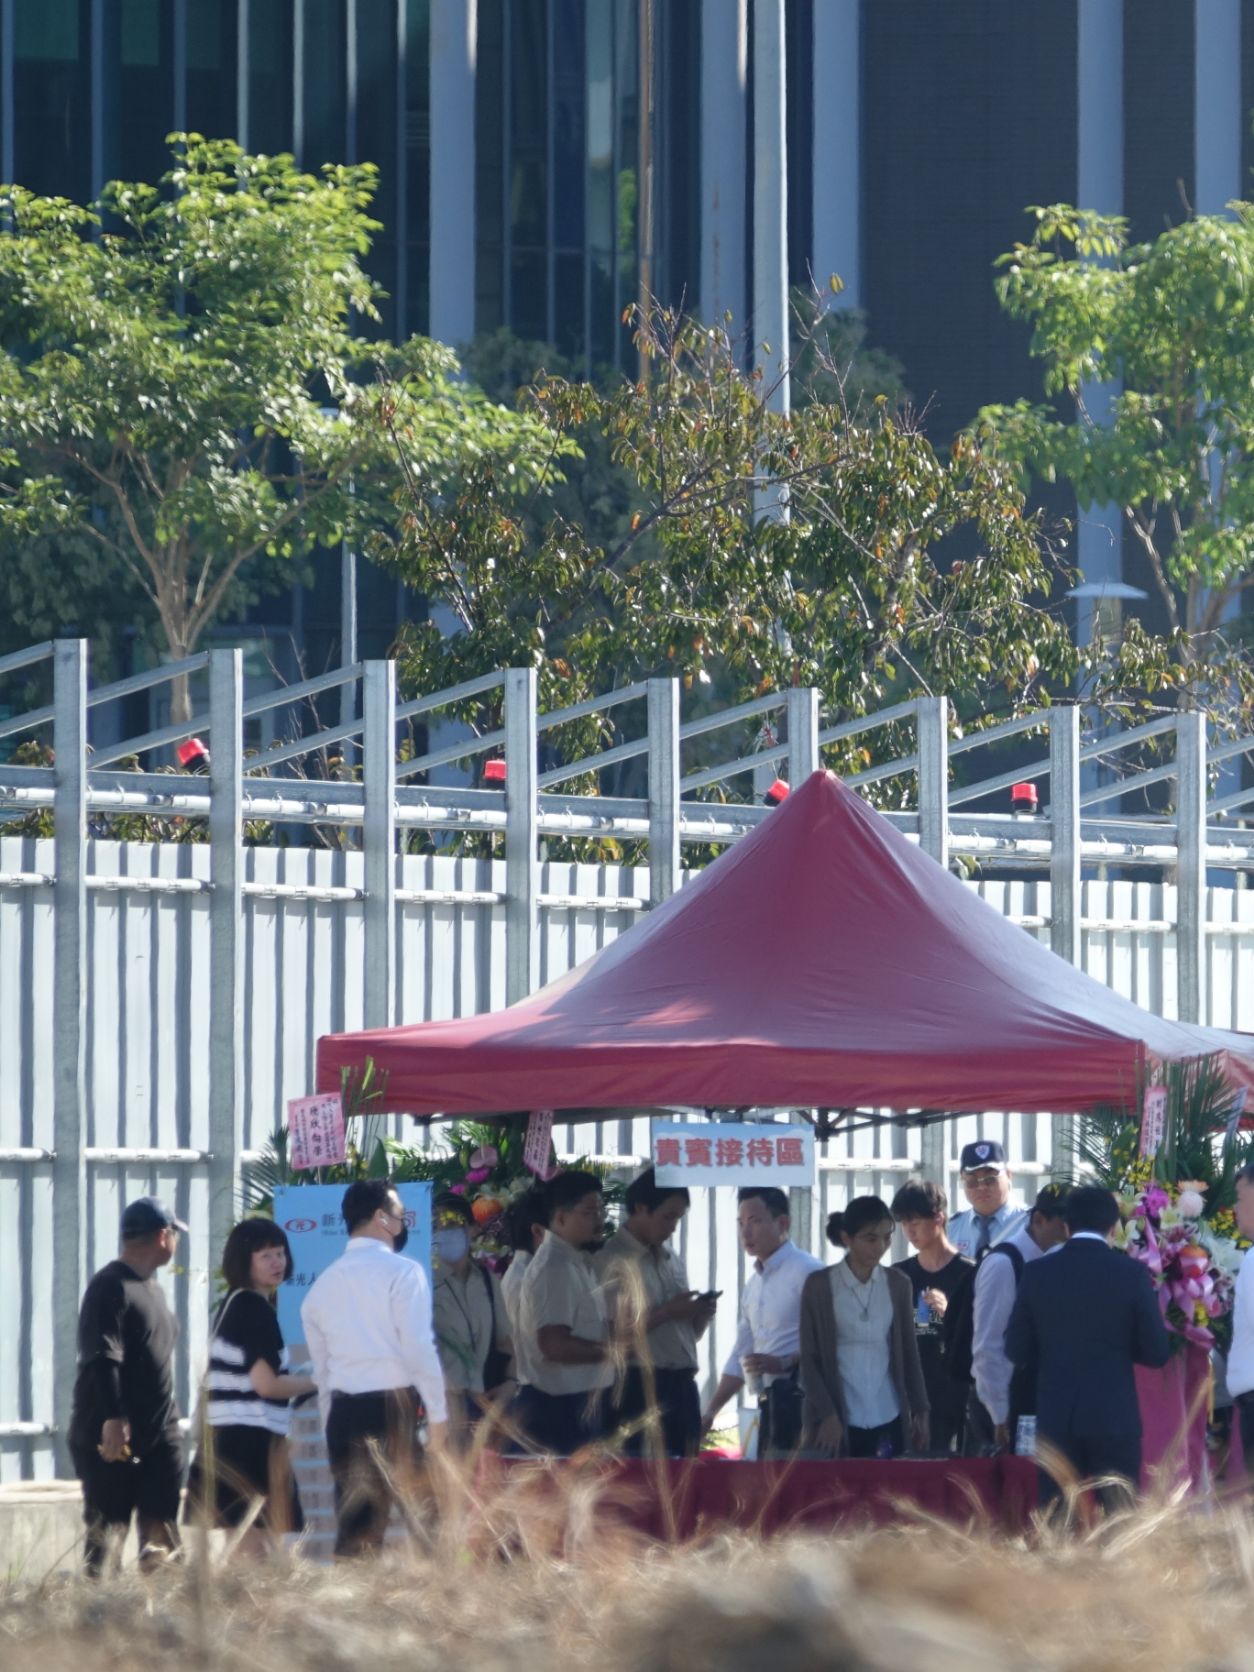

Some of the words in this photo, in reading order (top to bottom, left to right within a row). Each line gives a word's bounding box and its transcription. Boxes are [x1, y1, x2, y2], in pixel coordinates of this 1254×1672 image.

[655, 1137, 804, 1167] 貴賓接待區
